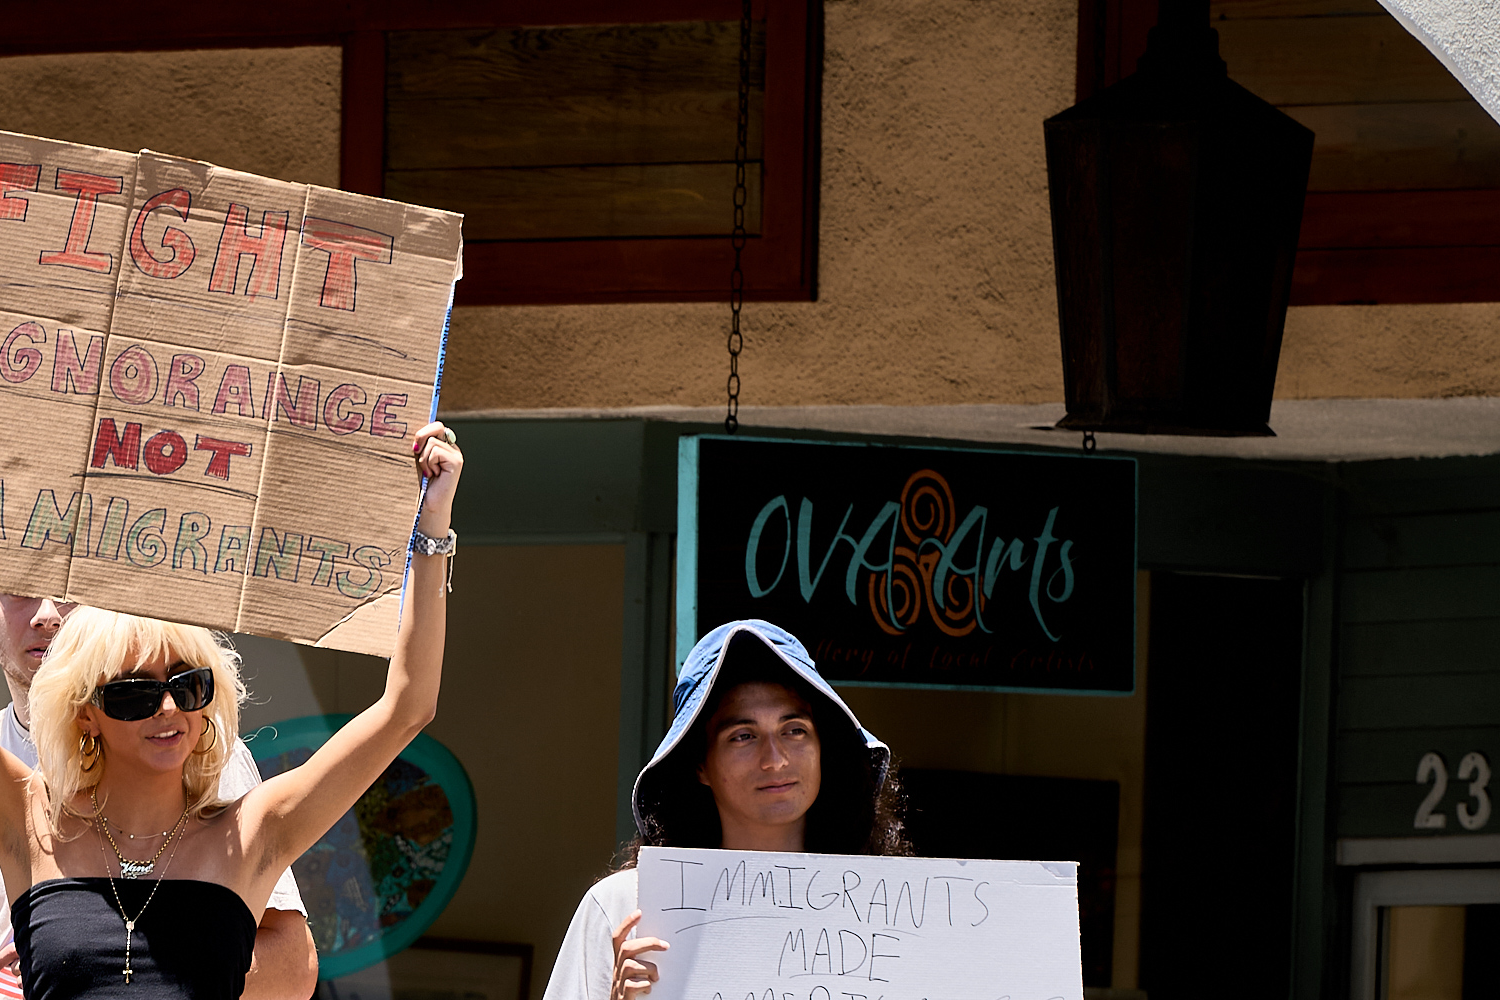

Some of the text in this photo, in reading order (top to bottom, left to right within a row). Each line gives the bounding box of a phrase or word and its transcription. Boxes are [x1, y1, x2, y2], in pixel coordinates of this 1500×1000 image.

[90, 417, 252, 480] NOT
[745, 494, 1080, 642] OVA Arts
[814, 638, 874, 677] llery
[1413, 752, 1492, 830] 23
[660, 858, 990, 928] IMMIGRANTS
[778, 928, 900, 982] MADE
